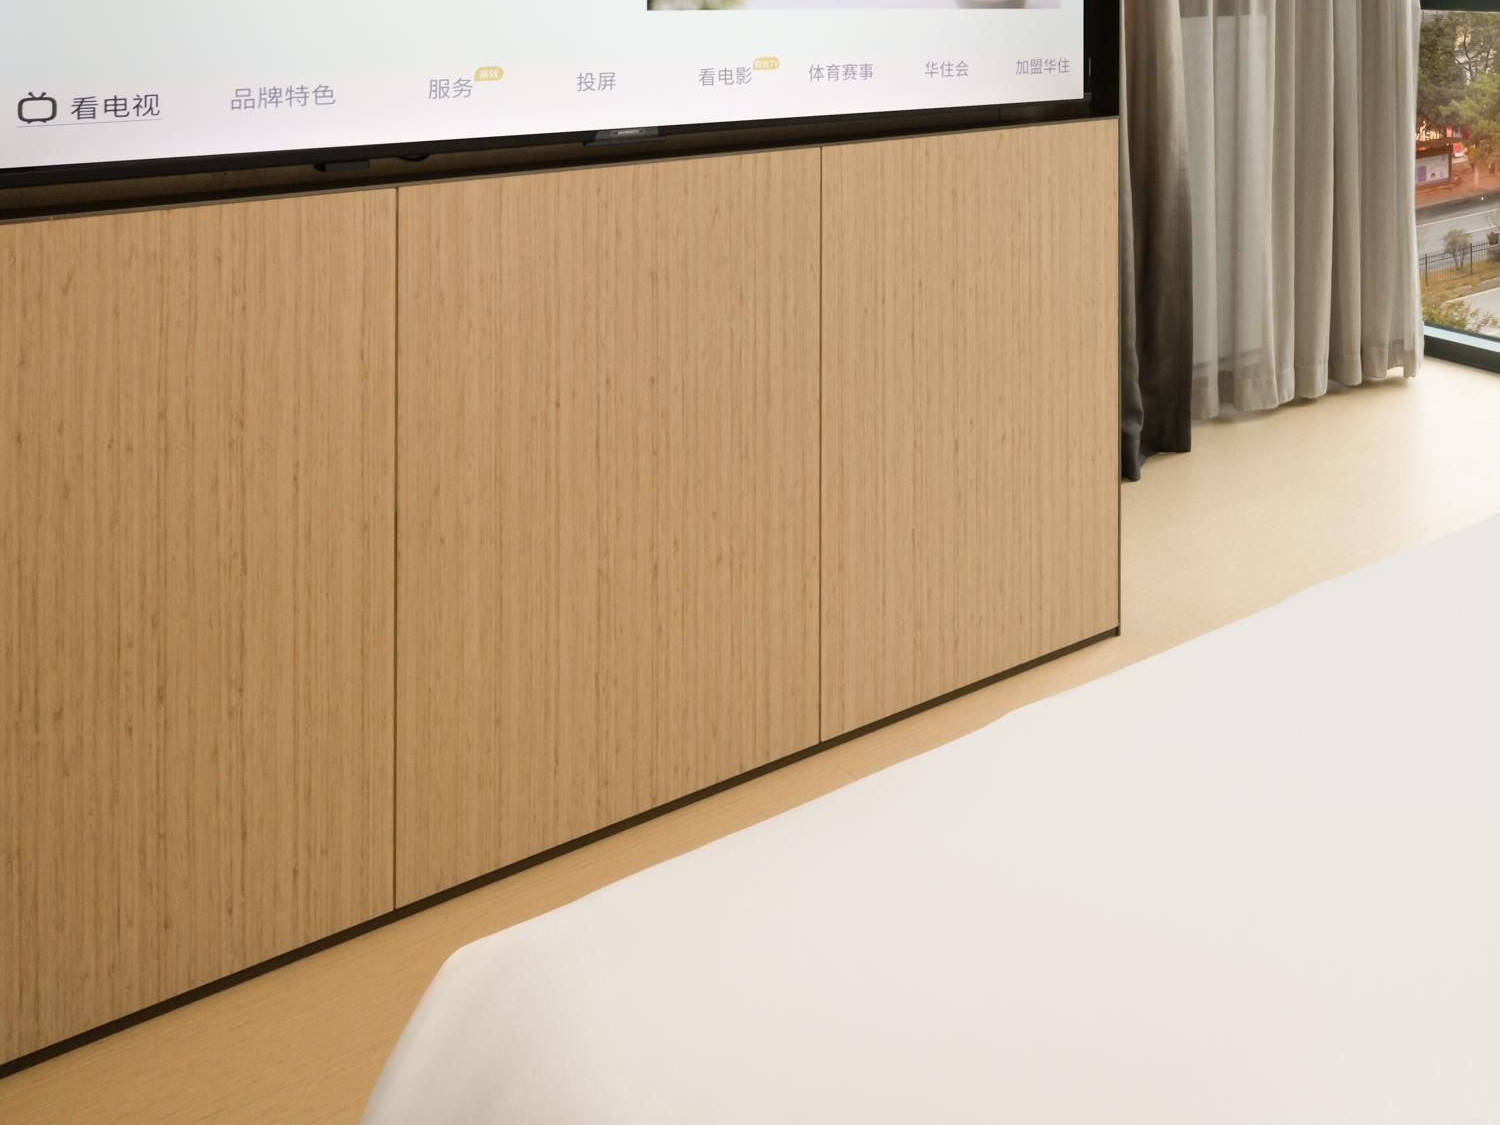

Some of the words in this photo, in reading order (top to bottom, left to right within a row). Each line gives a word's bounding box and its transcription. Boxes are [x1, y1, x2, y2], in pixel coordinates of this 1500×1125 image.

[808, 62, 874, 83] 体育赛事
[924, 60, 969, 79] 华住会
[1015, 57, 1071, 75] 加盟华住
[576, 71, 617, 92] 投屏
[698, 66, 753, 88] 看电影
[229, 84, 337, 112] 品牌特色
[427, 77, 474, 101] 服务
[70, 92, 162, 121] 看电视
